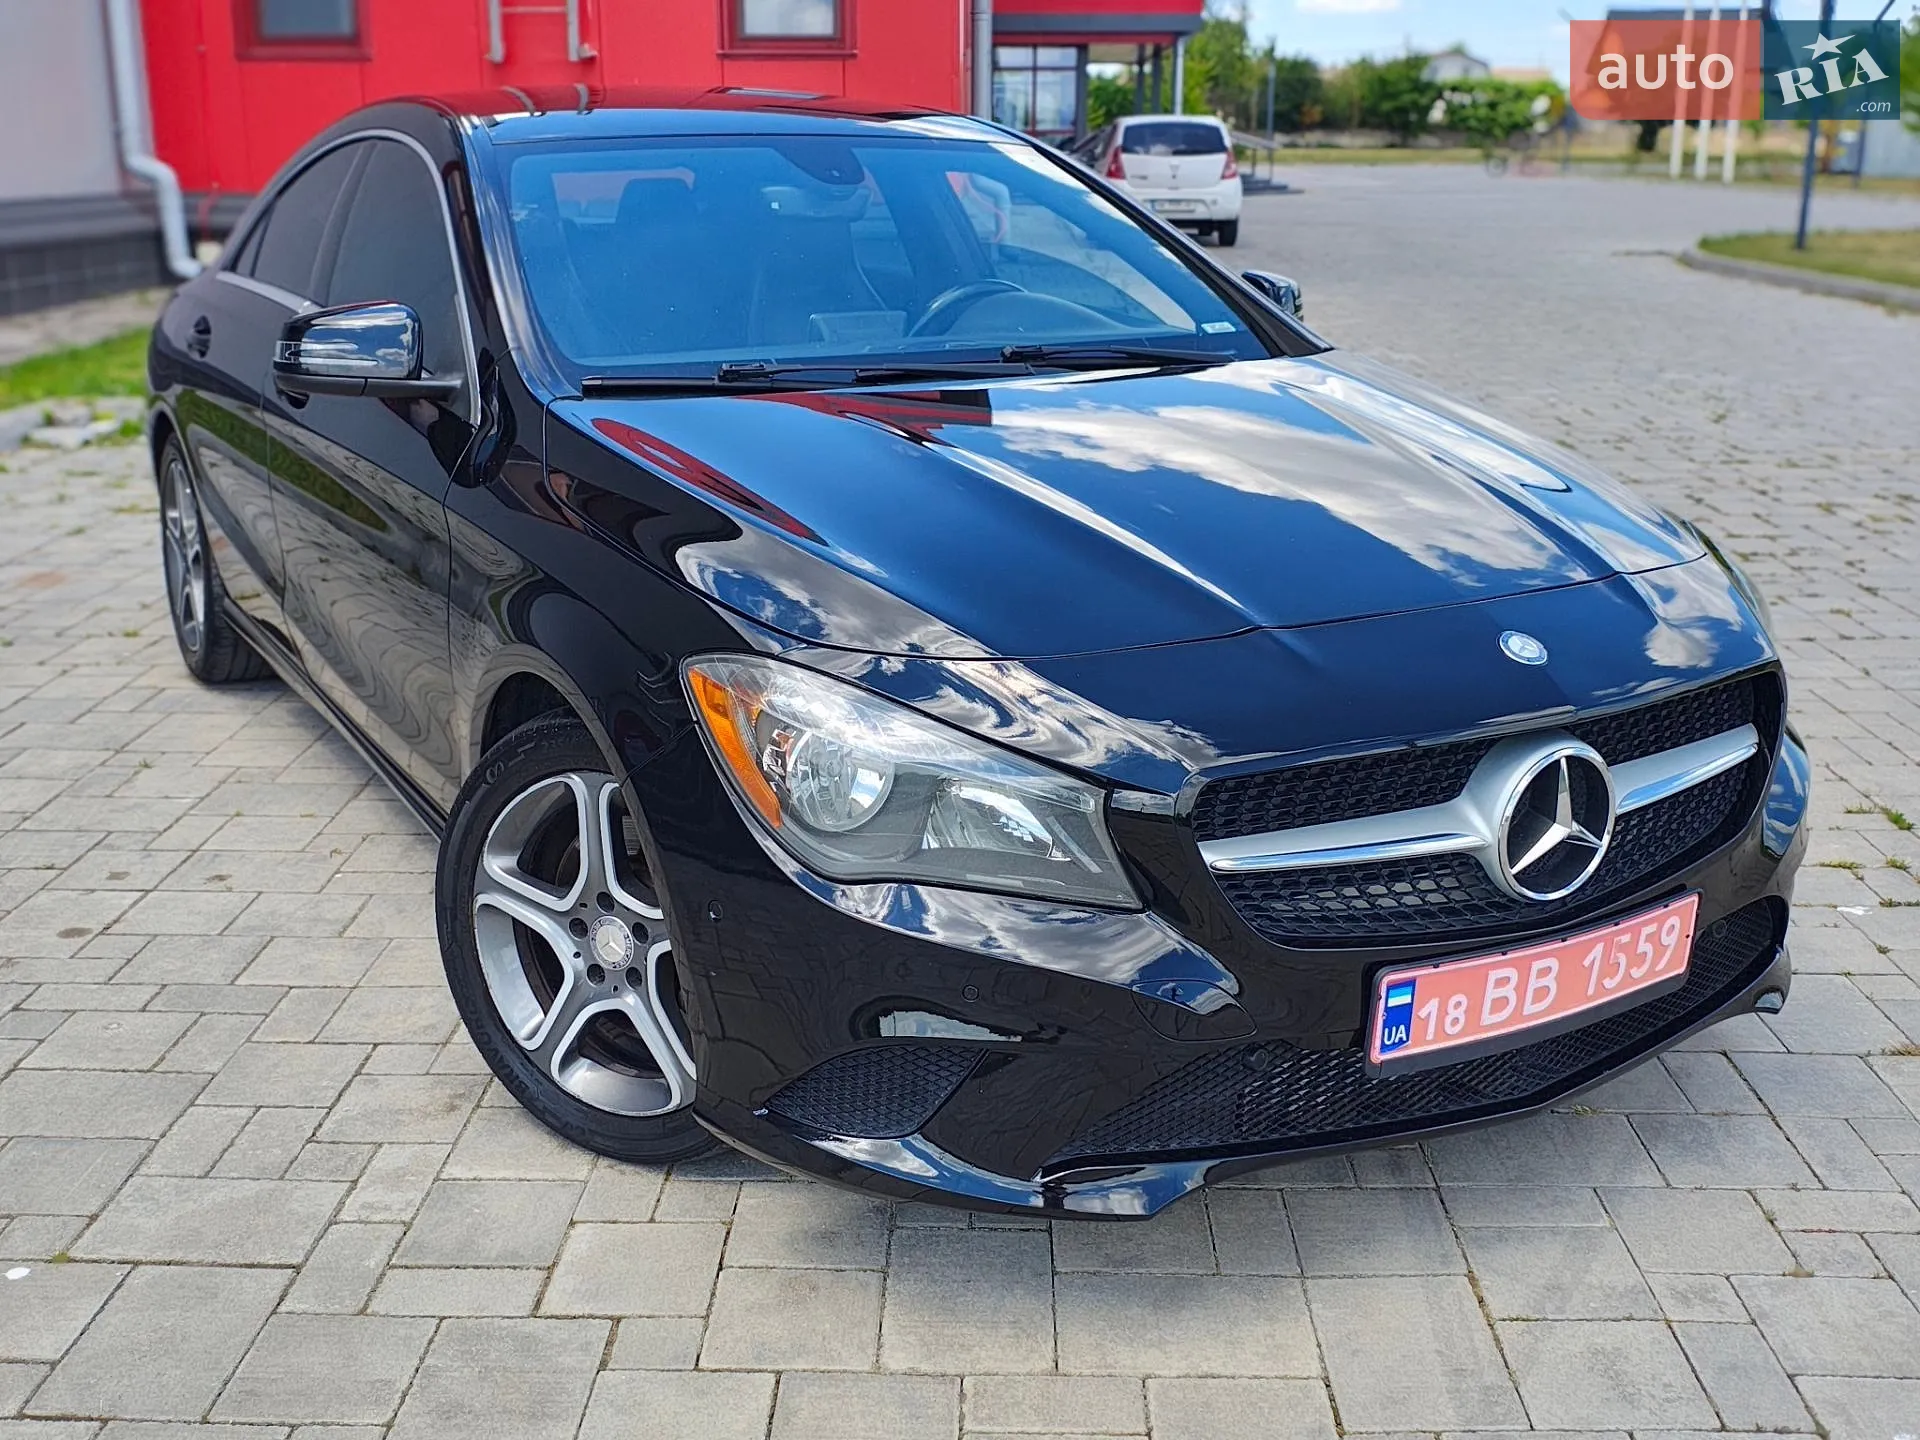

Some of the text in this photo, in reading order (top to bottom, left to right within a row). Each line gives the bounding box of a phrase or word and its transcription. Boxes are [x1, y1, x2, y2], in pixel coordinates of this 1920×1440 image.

[1416, 914, 1682, 1041] 18 BB 1559
[1383, 1023, 1408, 1046] UA
